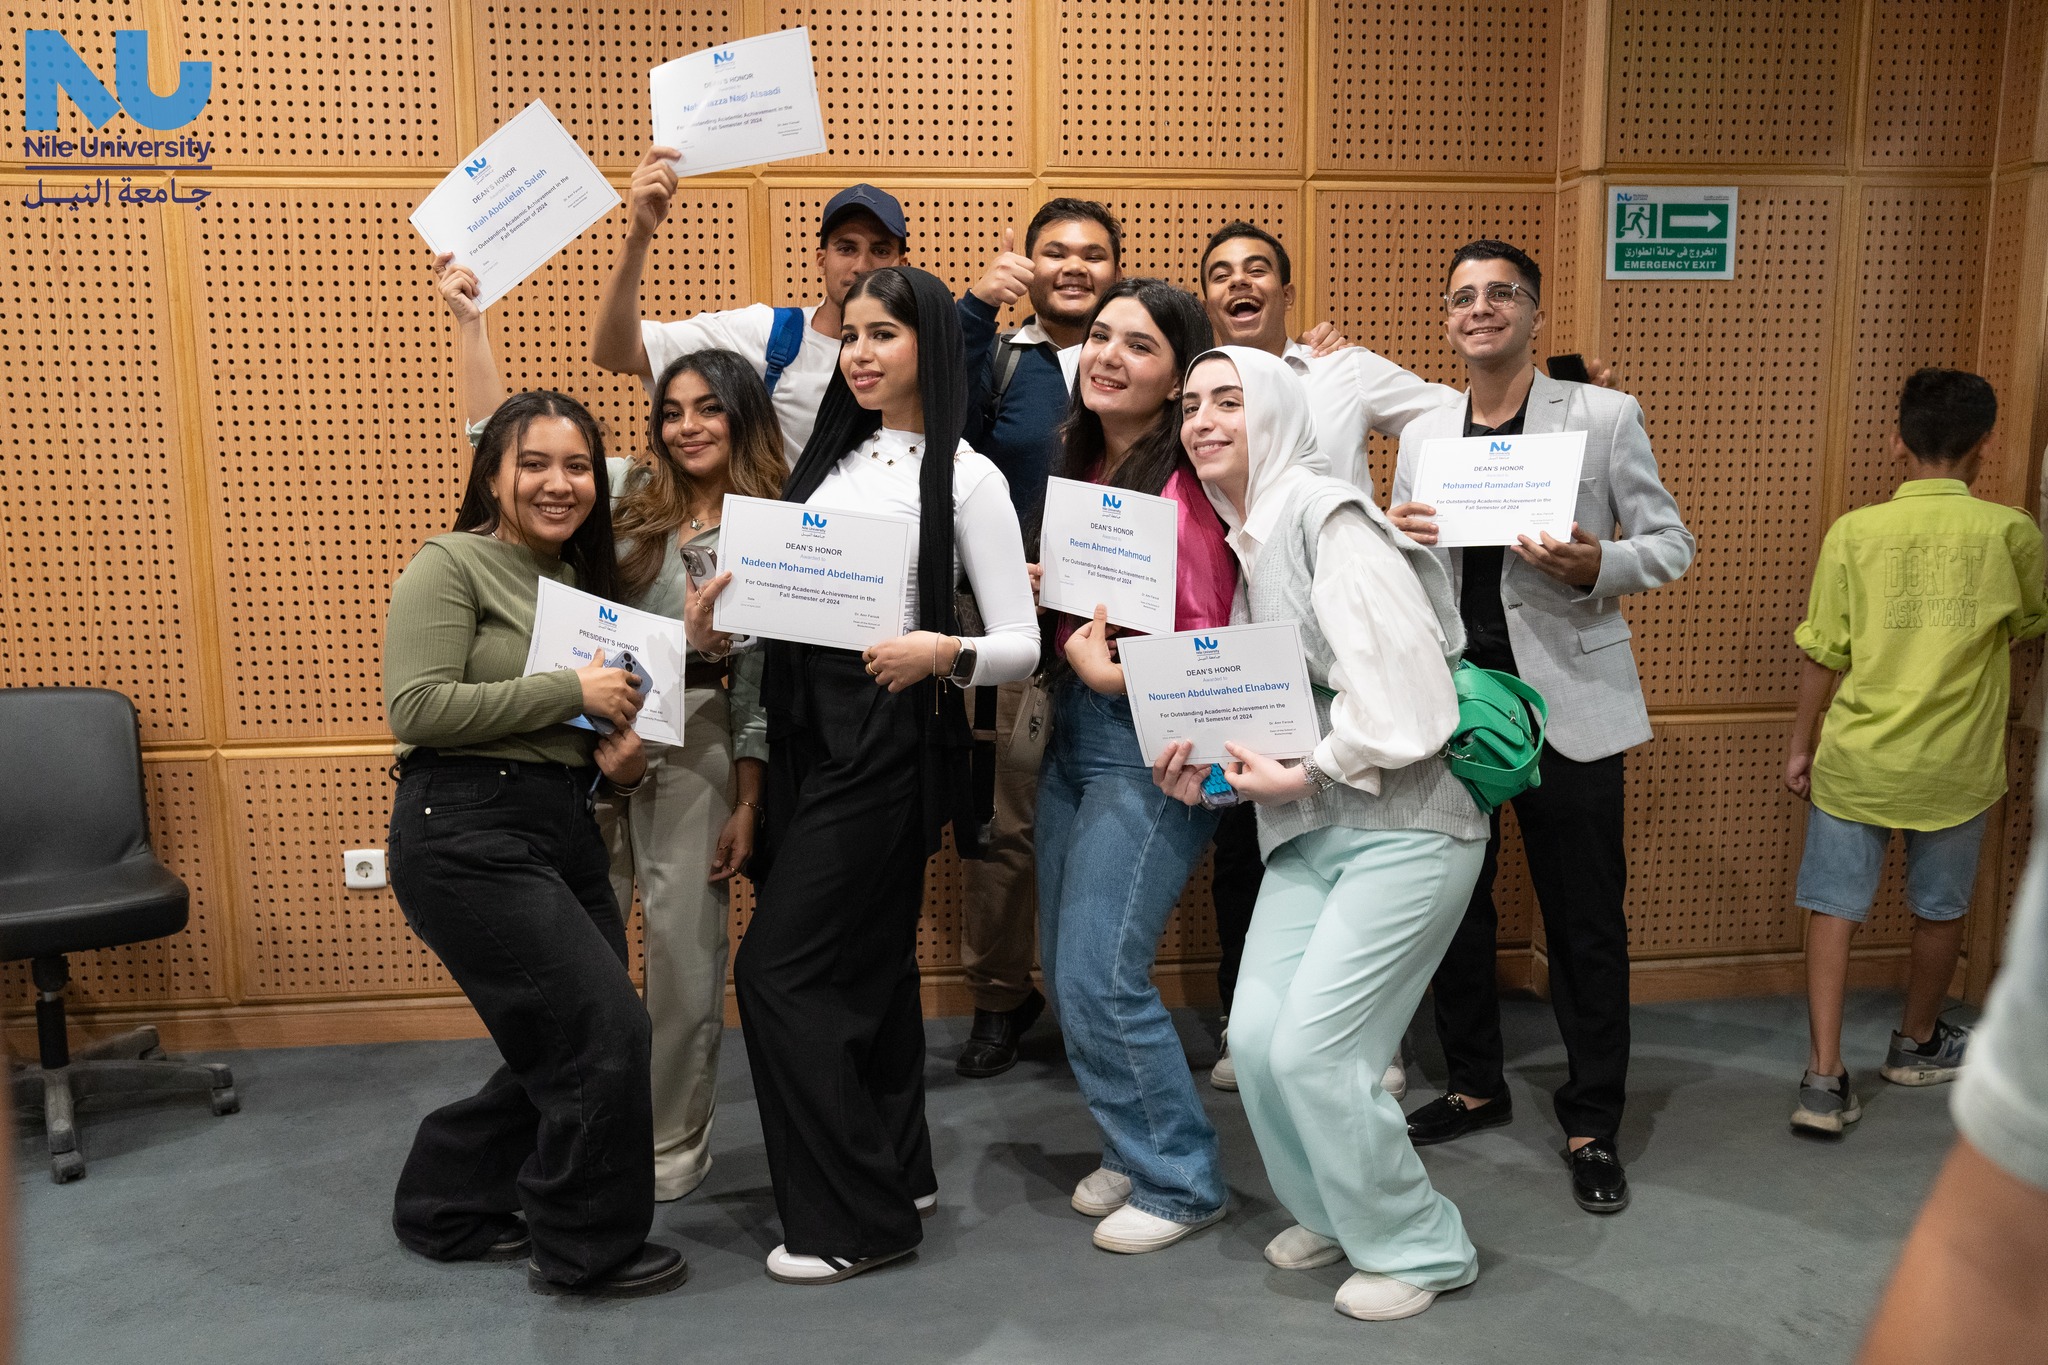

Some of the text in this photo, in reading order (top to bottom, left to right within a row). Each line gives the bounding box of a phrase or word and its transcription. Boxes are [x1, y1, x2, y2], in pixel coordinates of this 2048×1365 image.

[714, 51, 734, 65] NU
[730, 72, 754, 83] HONOR
[464, 157, 487, 177] NU
[472, 185, 495, 204] DEAN'S
[494, 166, 517, 186] HONOR
[467, 215, 489, 233] Talah
[488, 186, 526, 218] Abdulelah
[524, 169, 547, 188] Saleh
[1617, 193, 1632, 202] NU
[469, 248, 478, 256] For
[477, 226, 506, 250] Outstanding
[505, 209, 528, 228] Academic
[527, 185, 557, 210] Achievement
[560, 176, 569, 184] the
[500, 232, 511, 241] Fall
[509, 216, 531, 234] Semester
[536, 202, 548, 213] 2024
[1657, 246, 1675, 256] حالة
[1689, 247, 1717, 258] الخروج
[1624, 261, 1716, 269] EMERGENCY EXIT
[1490, 441, 1511, 452] NU
[1525, 480, 1551, 489] Sayed
[1103, 493, 1121, 508] NU
[803, 512, 827, 528] NU
[1090, 522, 1134, 536] DEAN'S HONOR
[785, 542, 842, 556] DEAN'S HONOR
[1070, 538, 1151, 563] Reem Ahmed Mahmoud
[741, 556, 884, 584] Nadeen Mohamed Abdelhamid
[1070, 558, 1097, 570] Outstanding
[1097, 564, 1118, 574] Academic
[1118, 569, 1145, 580] Achievement
[1884, 546, 1984, 597] DON'T
[1096, 572, 1116, 581] Semester
[1121, 577, 1132, 585] 2024
[756, 580, 791, 591] Outstanding
[792, 585, 820, 595] Academic
[821, 589, 859, 600] Achievement
[791, 593, 818, 602] Semester
[599, 606, 618, 622] NU
[1883, 598, 1979, 629] ASK WHY?
[579, 629, 616, 646] PRESIDENT'S
[616, 641, 639, 652] HONOR
[1194, 637, 1218, 651] NU
[572, 646, 592, 660] Sarah
[1186, 665, 1241, 677] DEAN'S HONOR
[1148, 682, 1290, 701] Noureen Abdulwahed Elnabawy
[1170, 710, 1204, 718] Outstanding
[1232, 704, 1269, 712] Achievement
